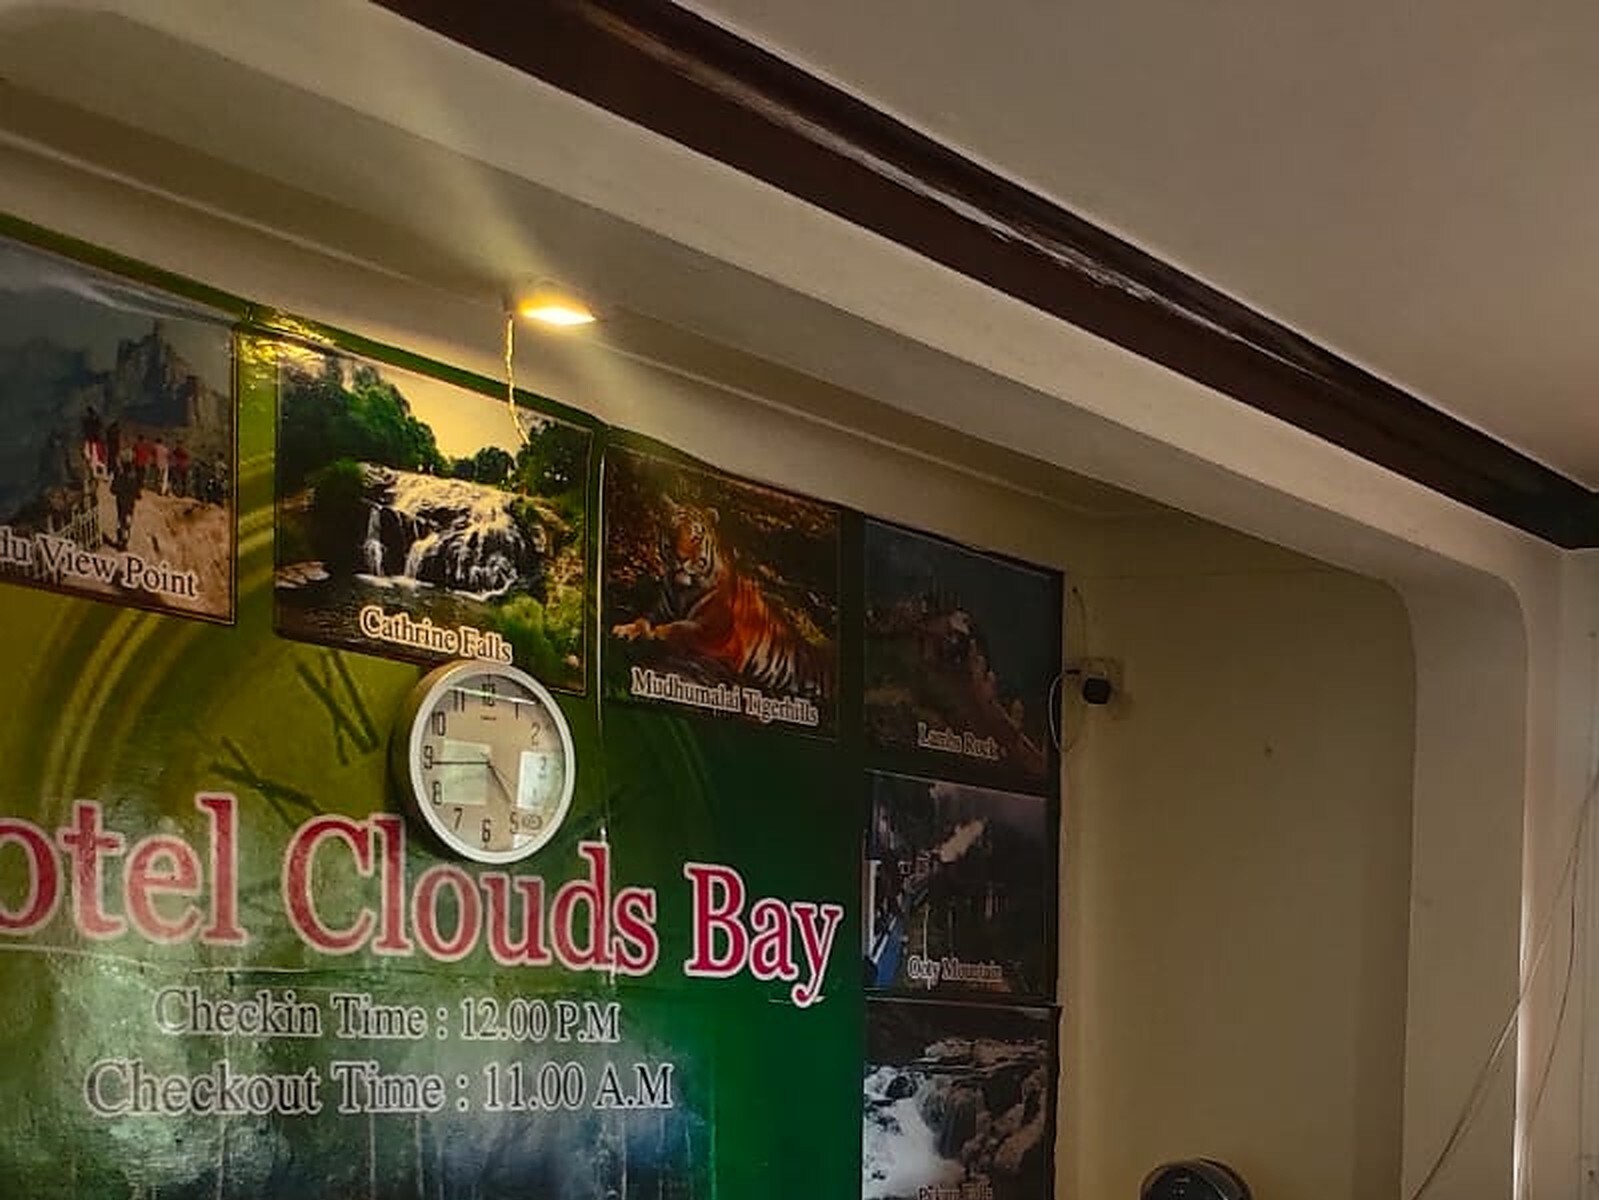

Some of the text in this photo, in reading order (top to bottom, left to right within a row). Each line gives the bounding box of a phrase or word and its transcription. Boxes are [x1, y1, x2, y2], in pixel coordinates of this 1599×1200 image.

[36, 532, 117, 582] View
[121, 553, 199, 600] Point
[360, 605, 513, 666] Cathrine Falls
[431, 711, 446, 737] 10
[631, 666, 820, 727] Mudhumalai Tigerhills
[453, 807, 463, 831] 7
[481, 819, 492, 843] 6
[283, 814, 659, 977] Clouds
[683, 862, 843, 1008] Bay
[154, 985, 321, 1038] Checkin
[331, 993, 429, 1039] Time
[460, 997, 550, 1042] 12.00
[554, 1002, 621, 1043] P.M
[84, 1056, 322, 1117] Checkout
[331, 1060, 446, 1115] Time
[483, 1061, 586, 1112] 11.00
[592, 1062, 675, 1110] A.M
